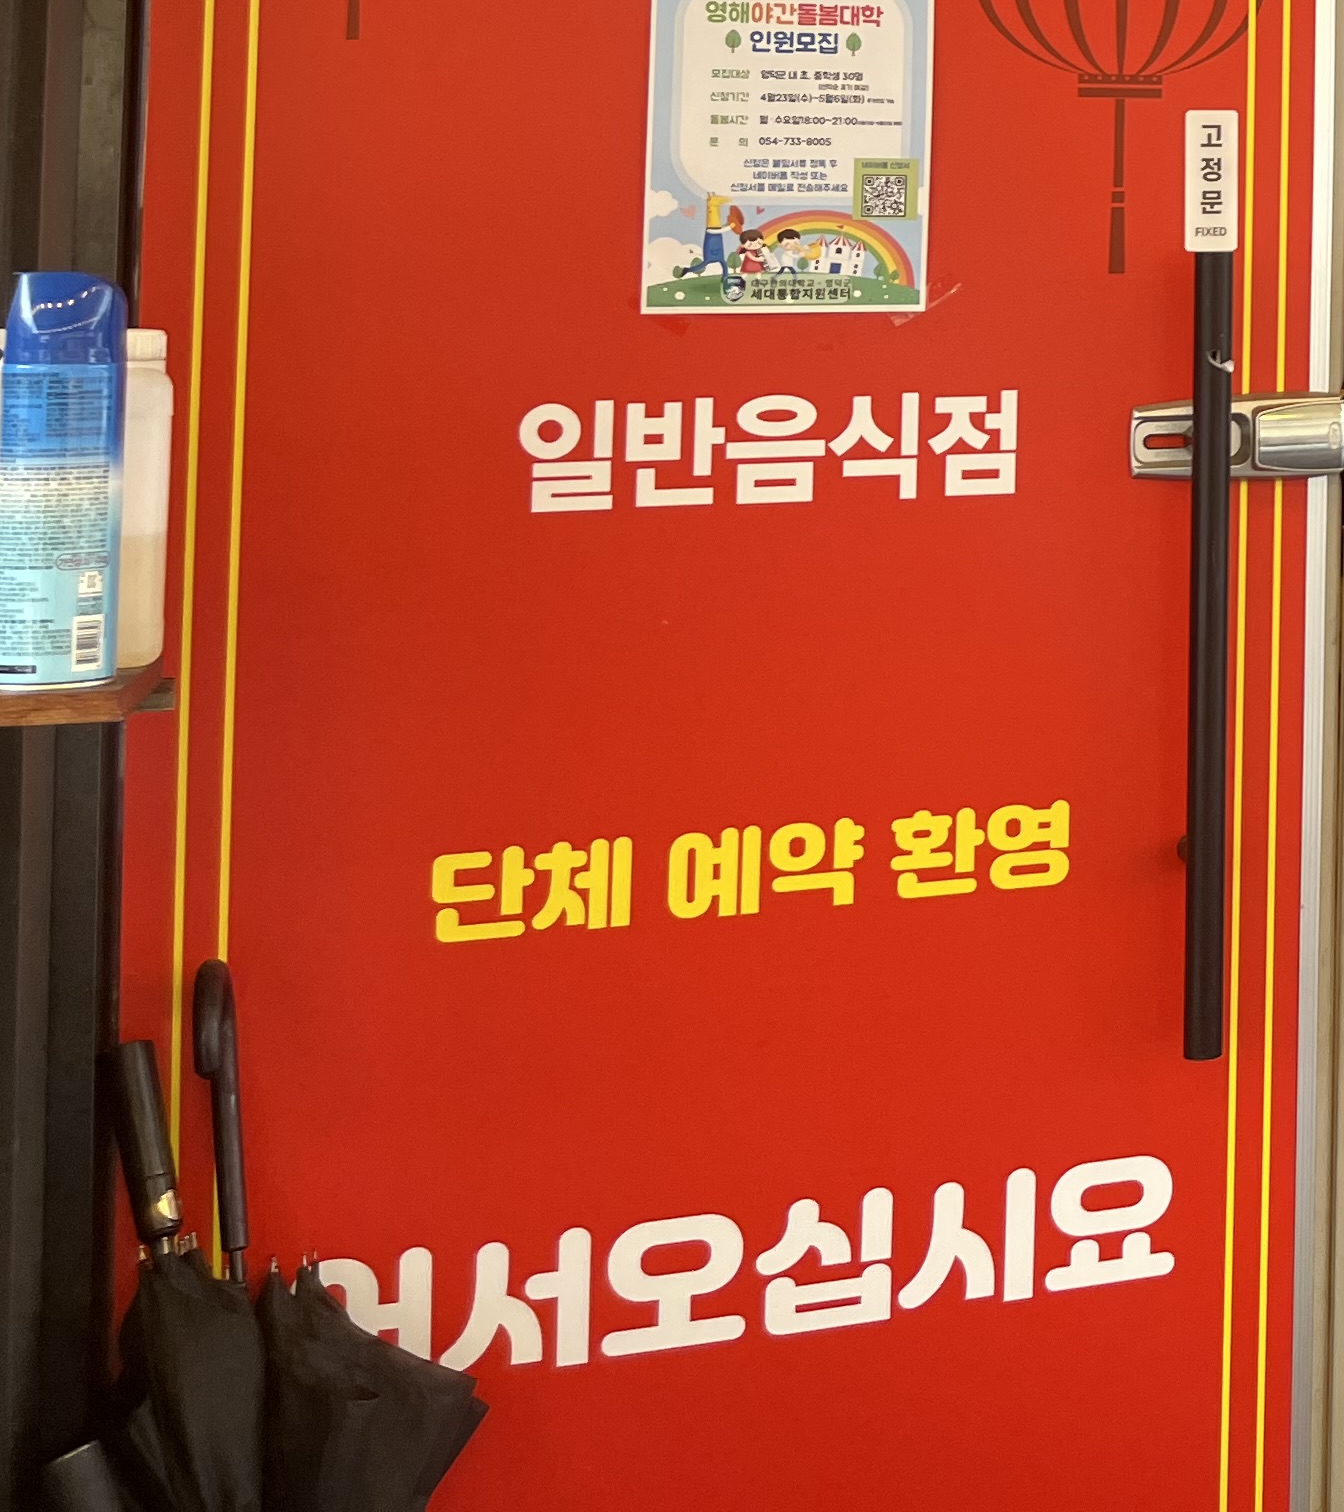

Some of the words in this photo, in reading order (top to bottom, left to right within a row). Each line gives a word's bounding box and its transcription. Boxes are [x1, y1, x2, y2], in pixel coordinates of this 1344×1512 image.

[705, 1, 884, 27] 영해야간돌봄대학
[750, 30, 839, 54] 인원모집
[842, 71, 863, 81] 30명
[759, 137, 831, 147] 054-733-8005
[1200, 124, 1223, 215] 고정문
[1194, 226, 1227, 237] FIXED
[750, 288, 851, 300] 세대통합지원센터
[518, 390, 1018, 513] 일반음식점
[431, 836, 633, 943] 단체
[667, 818, 865, 919] 예약
[890, 800, 1070, 899] 환영
